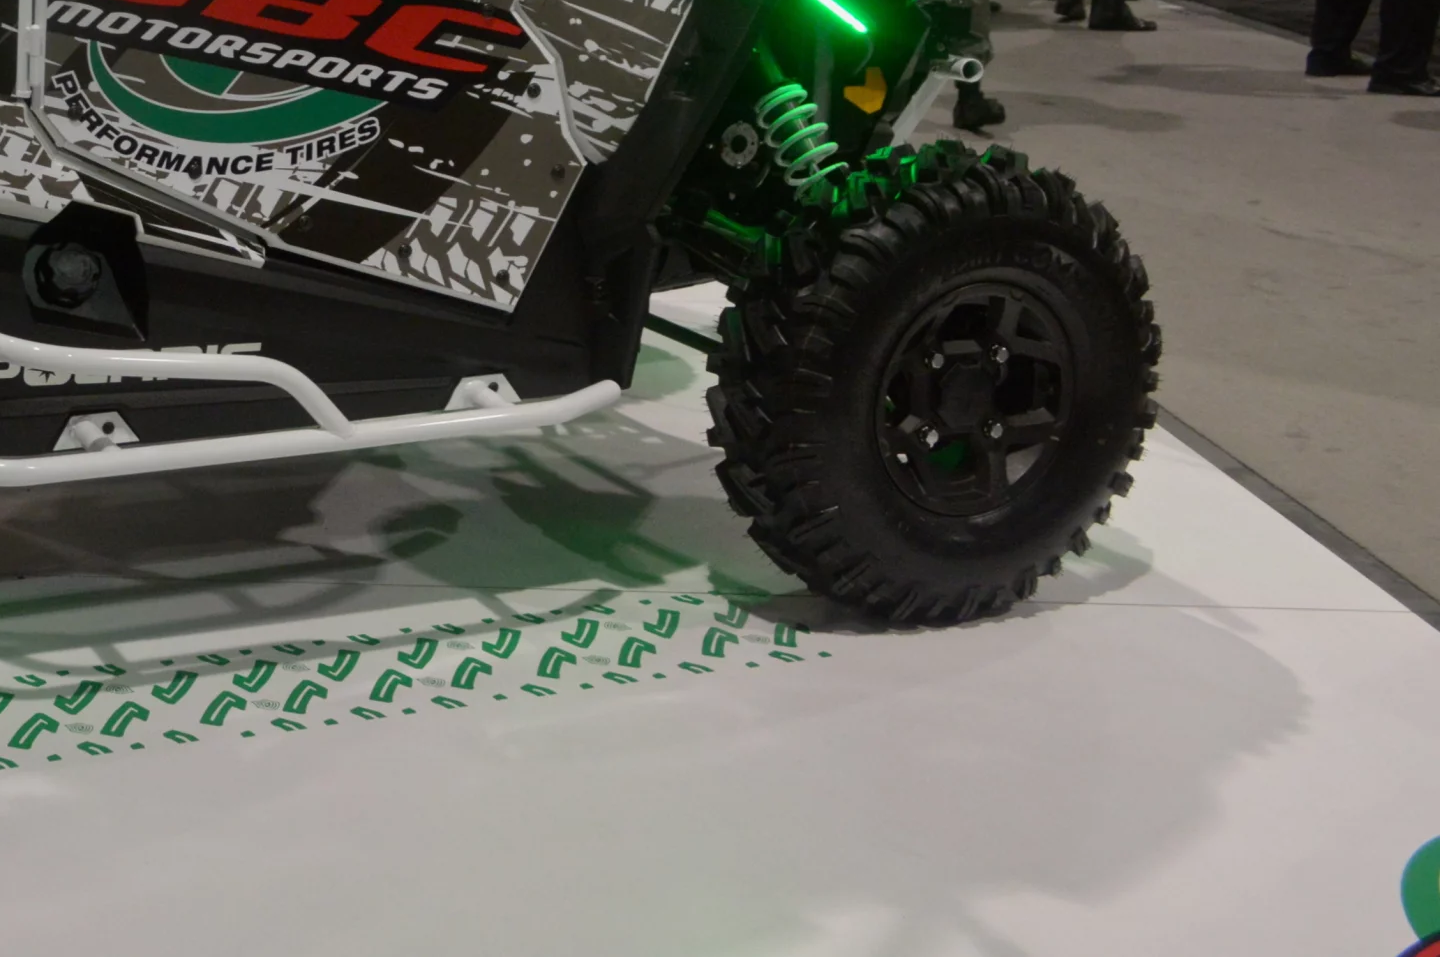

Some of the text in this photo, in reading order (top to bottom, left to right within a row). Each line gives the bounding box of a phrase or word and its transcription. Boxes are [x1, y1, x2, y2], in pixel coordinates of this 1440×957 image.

[47, 0, 450, 100] MOTORSPORTS
[53, 70, 383, 176] PERFORMANCE TIRES
